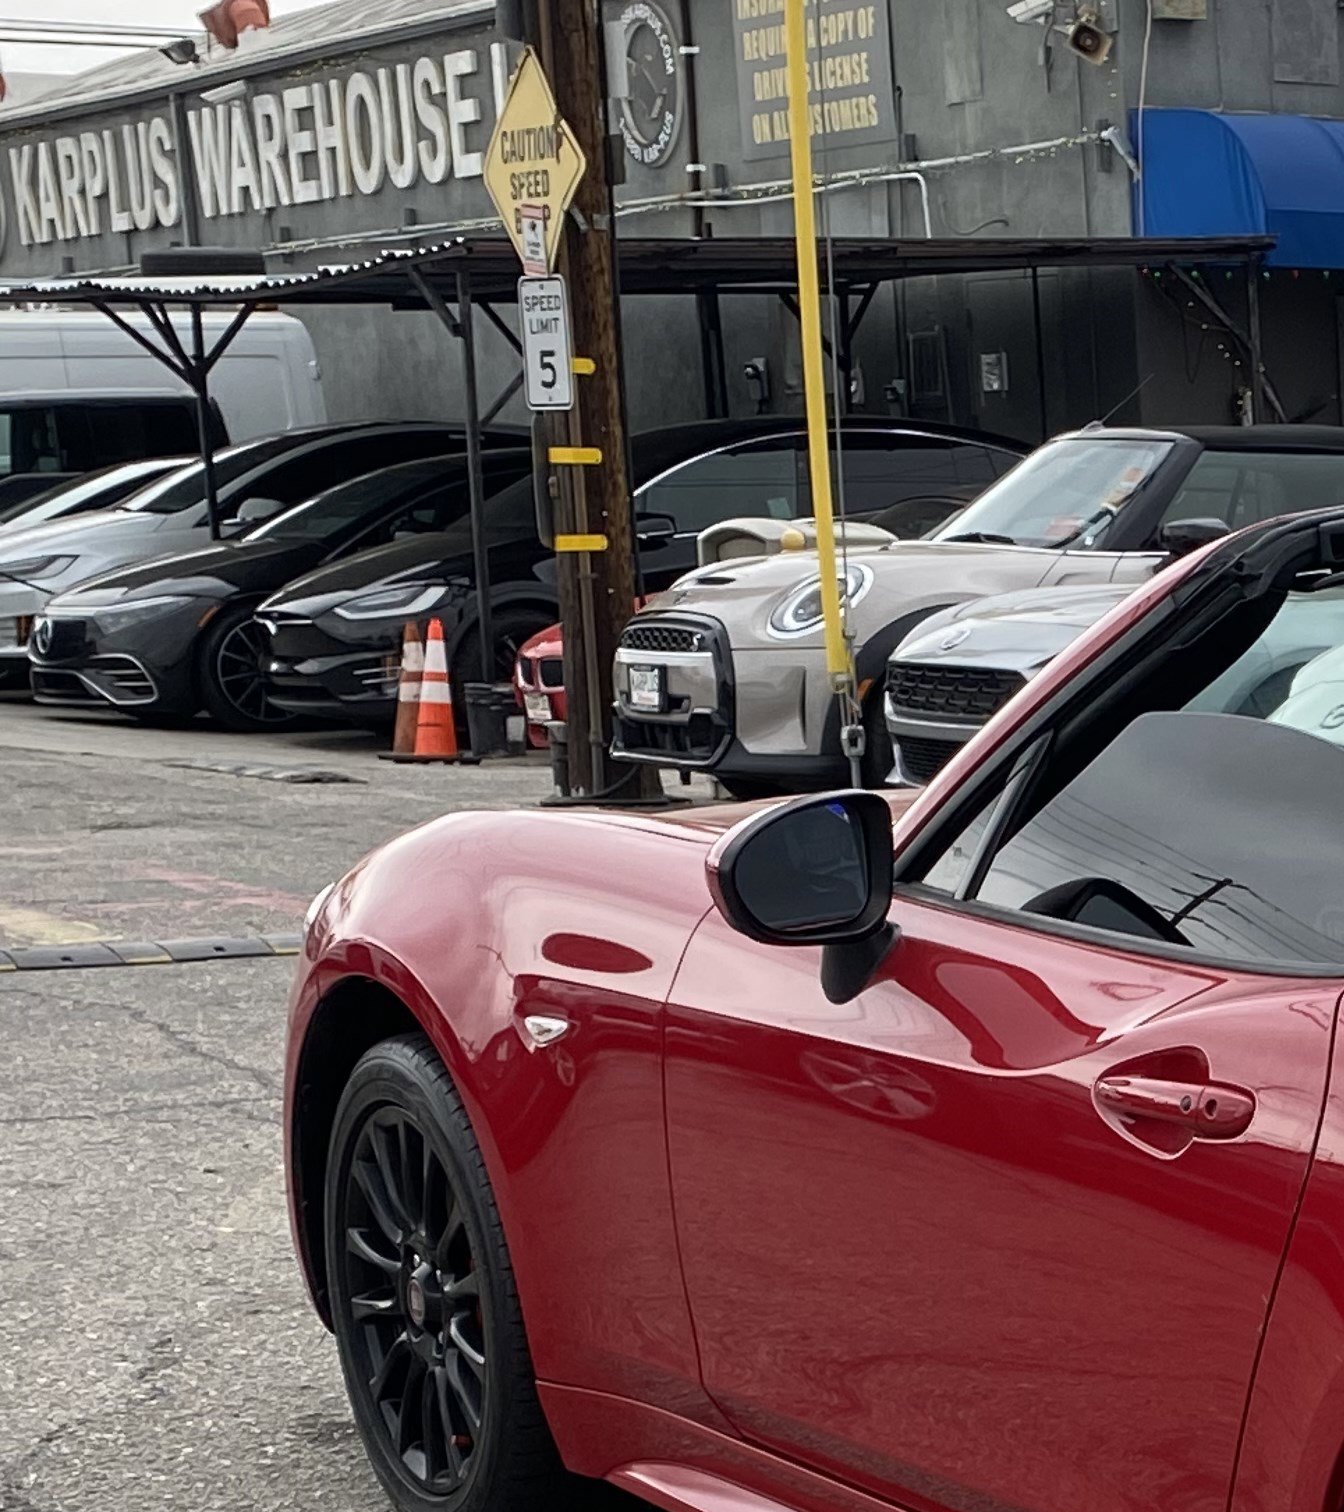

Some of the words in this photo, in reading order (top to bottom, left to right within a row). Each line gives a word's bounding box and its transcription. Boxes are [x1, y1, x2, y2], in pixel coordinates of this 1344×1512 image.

[820, 10, 854, 47] COPY
[857, 6, 875, 39] OF
[813, 52, 870, 91] LICENSE
[752, 113, 772, 144] ON
[807, 94, 878, 136] USTOMERS
[9, 116, 181, 246] KARPLUS
[187, 49, 484, 218] WAREHOUSE
[501, 125, 558, 164] CAUTION
[510, 169, 549, 200] SPEED
[524, 294, 561, 312] SPEED
[528, 317, 559, 335] LIMIT
[539, 350, 556, 389] 5
